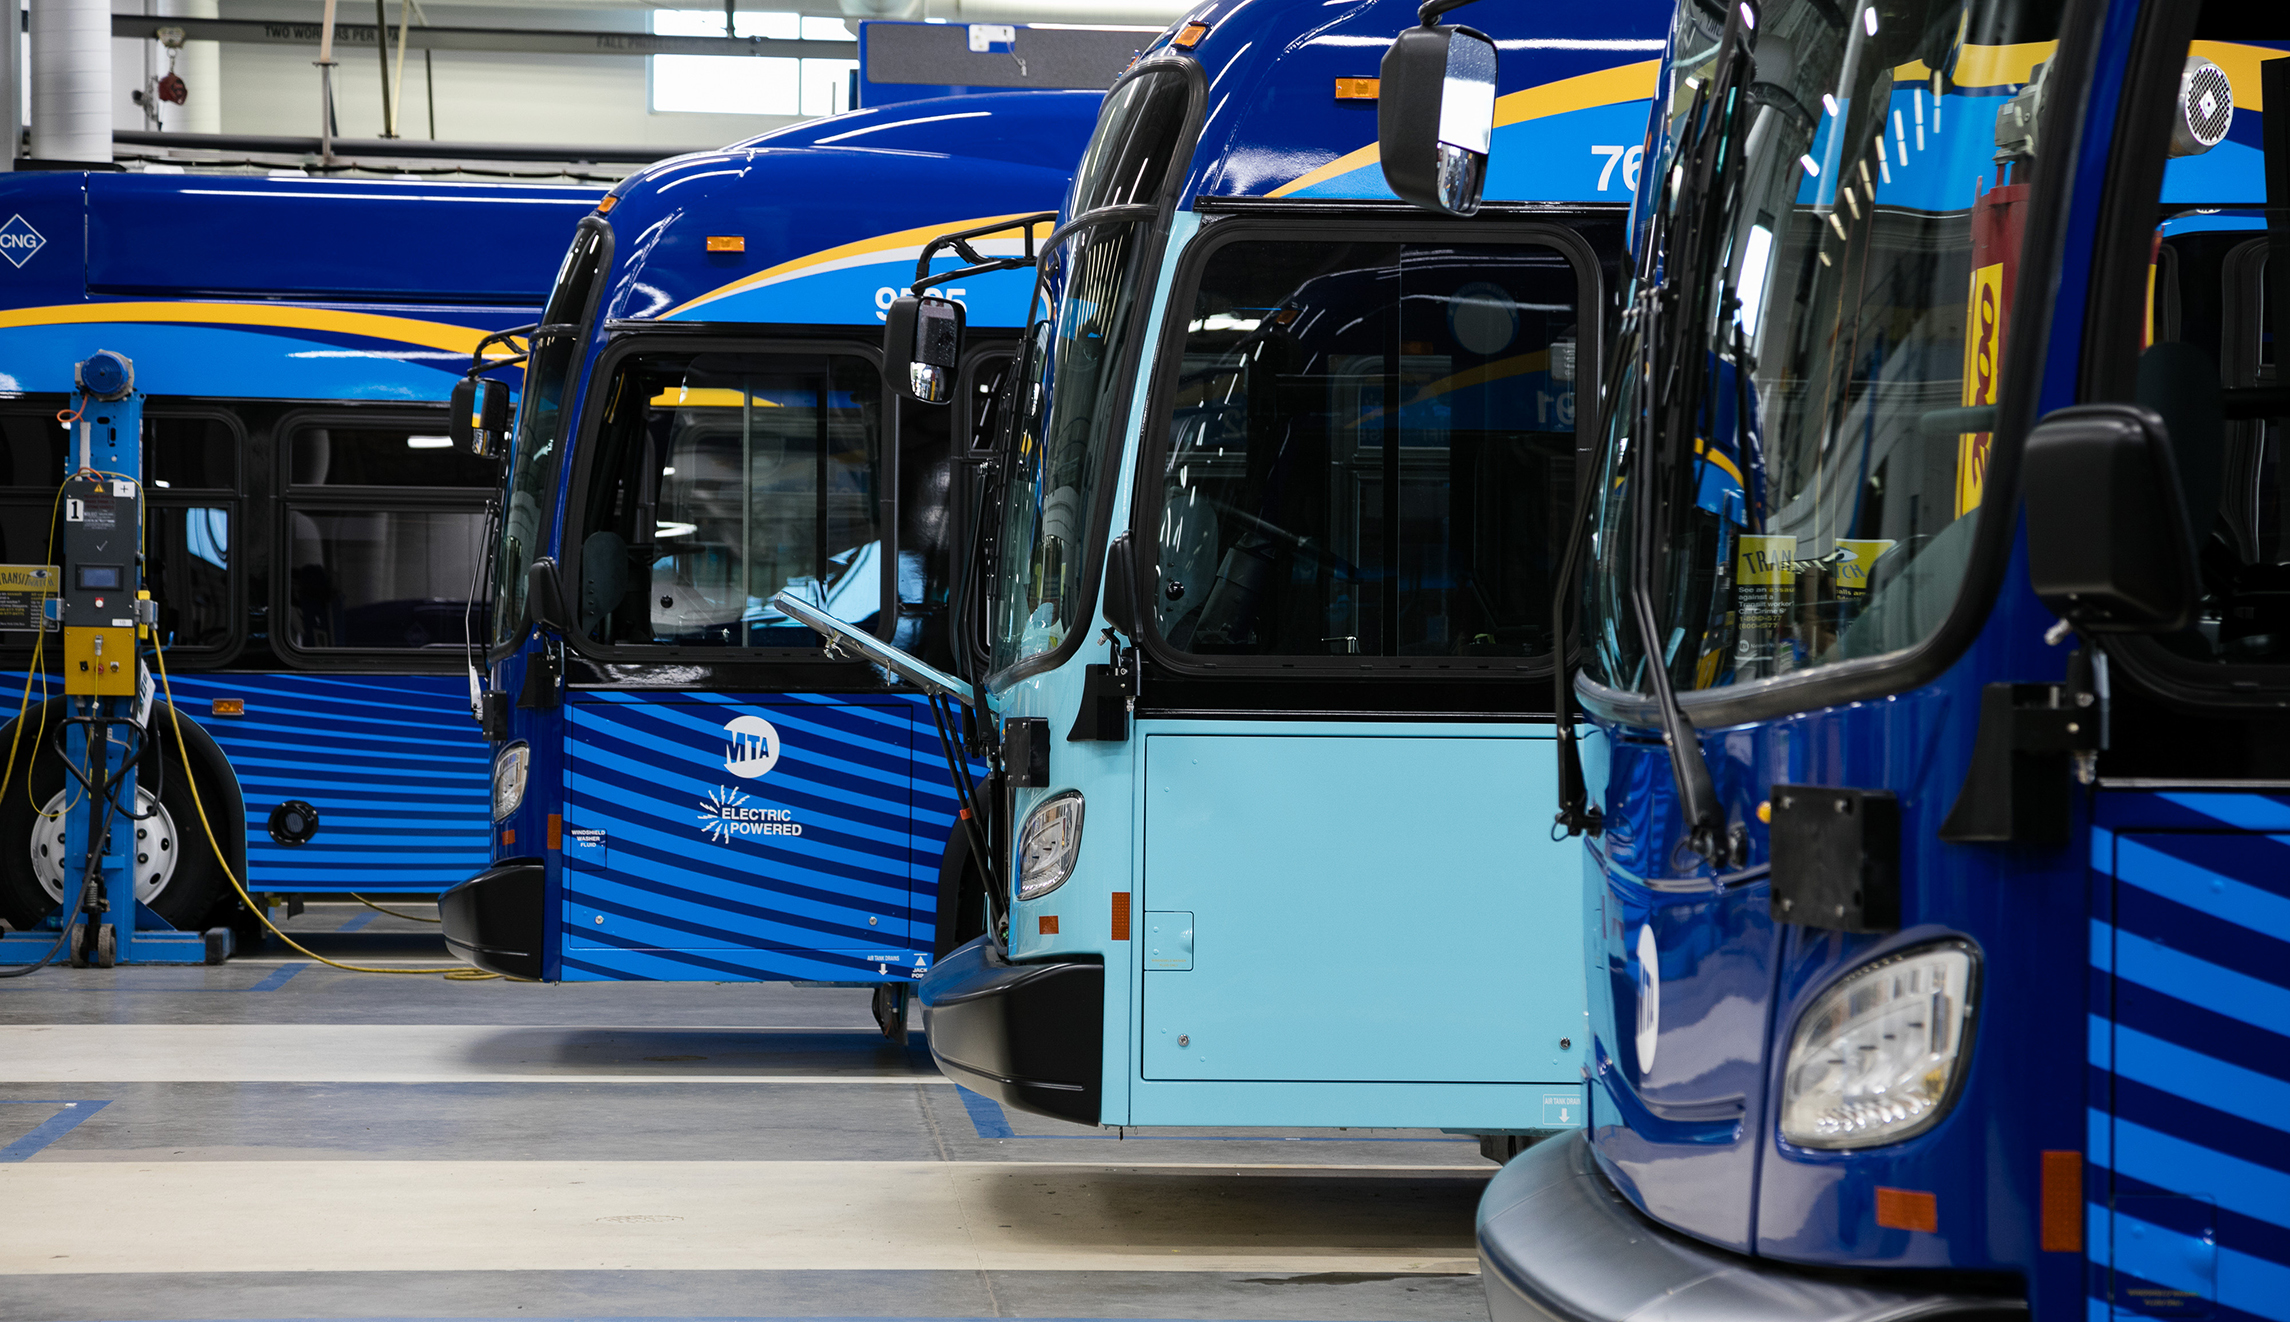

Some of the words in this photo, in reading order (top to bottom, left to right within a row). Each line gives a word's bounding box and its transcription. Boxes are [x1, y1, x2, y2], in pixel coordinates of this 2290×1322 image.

[264, 25, 290, 39] TWO
[293, 26, 349, 41] WORRS
[352, 29, 376, 42] PER
[0, 233, 37, 248] CNG
[875, 286, 968, 322] 95
[1742, 549, 1796, 575] TRAN
[0, 572, 30, 587] RANSIT
[723, 727, 770, 765] MTA
[721, 807, 792, 822] ELECTRIC
[730, 822, 803, 837] POWERED
